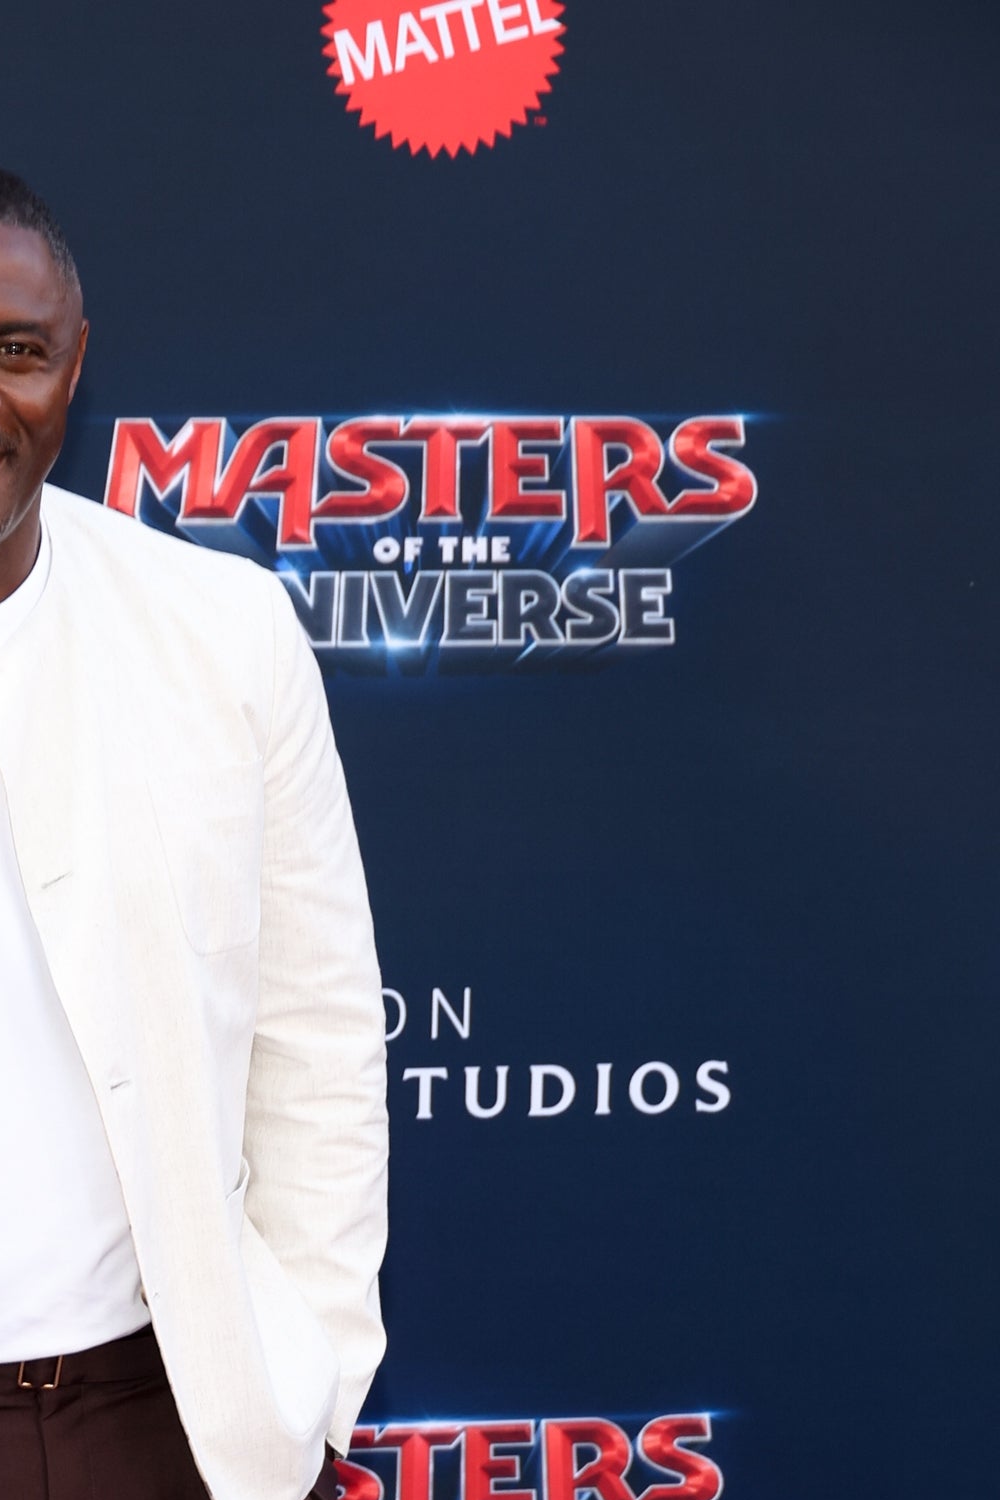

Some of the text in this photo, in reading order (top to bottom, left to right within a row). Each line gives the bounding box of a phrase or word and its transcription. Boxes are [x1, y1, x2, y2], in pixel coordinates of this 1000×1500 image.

[333, 0, 562, 86] MATTEL
[104, 416, 757, 549] MASTERS
[373, 536, 511, 564] OF THE
[275, 568, 675, 648] NIVERSE
[403, 1060, 731, 1120] TUDIOS
